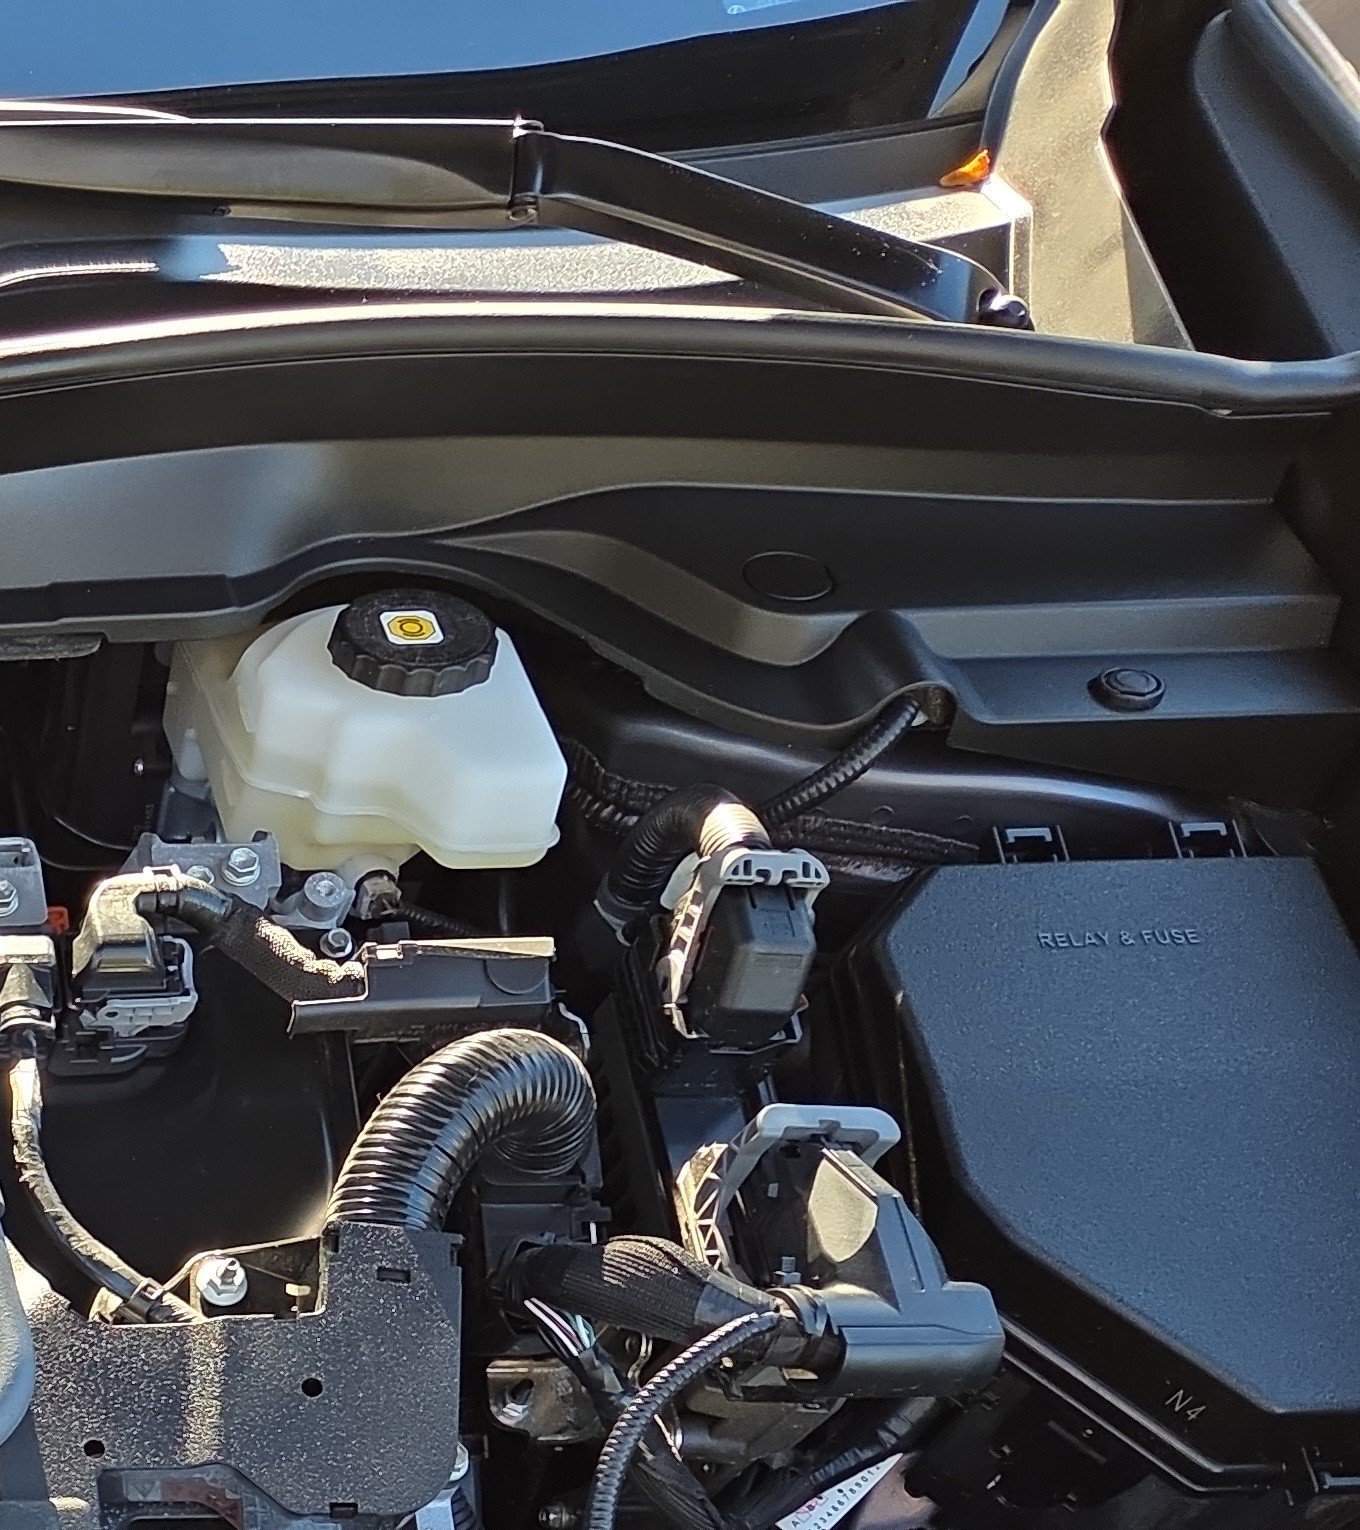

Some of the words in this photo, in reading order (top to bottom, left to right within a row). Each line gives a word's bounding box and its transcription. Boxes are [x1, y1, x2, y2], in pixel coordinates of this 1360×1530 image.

[1037, 930, 1110, 949] RELAY
[1119, 929, 1135, 947] &
[1140, 928, 1202, 946] FUSE
[1164, 1388, 1207, 1421] N4
